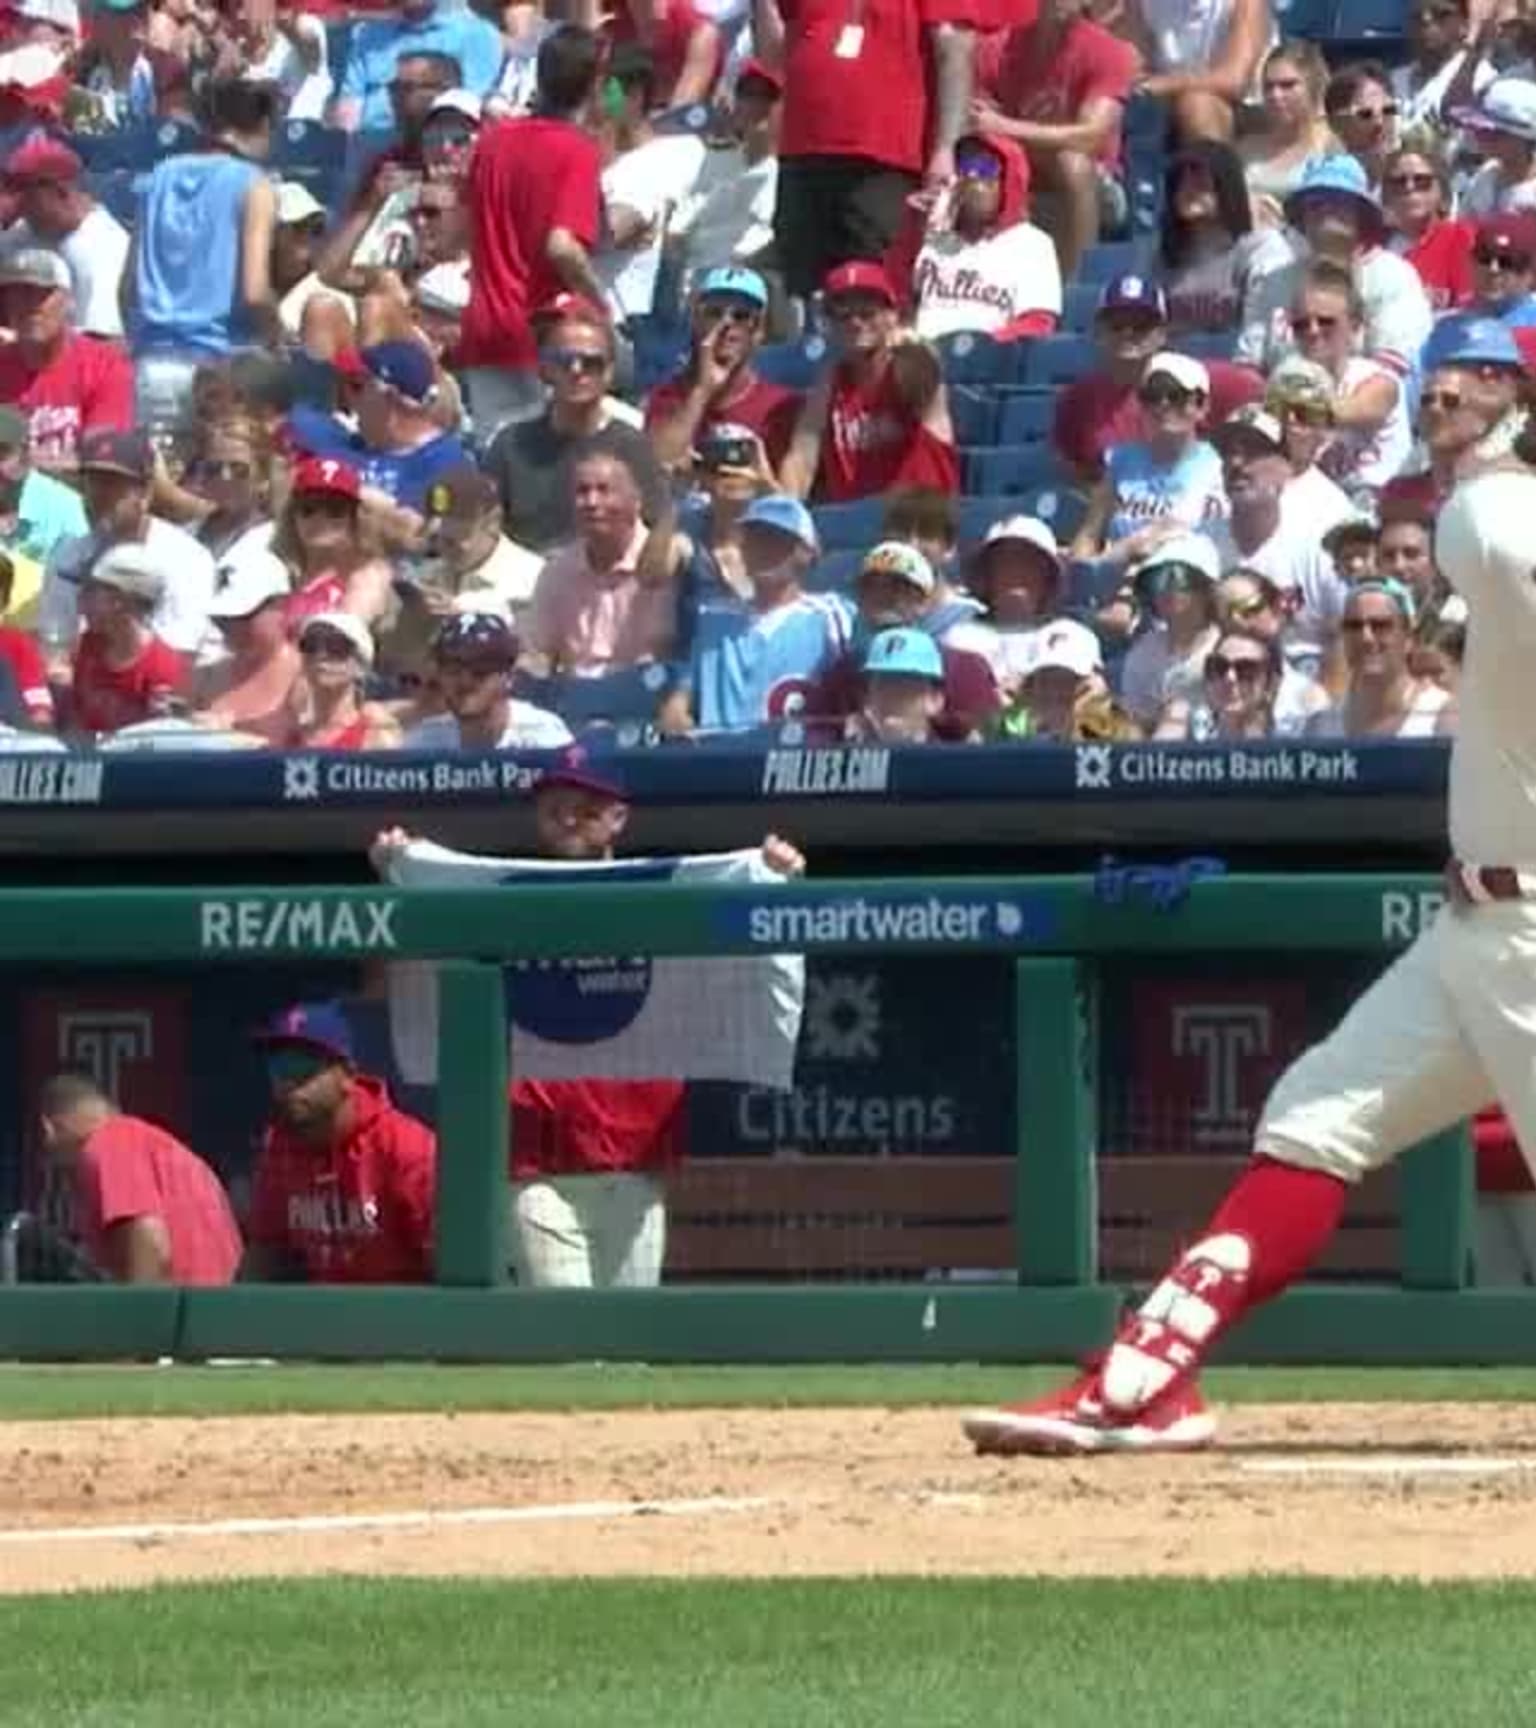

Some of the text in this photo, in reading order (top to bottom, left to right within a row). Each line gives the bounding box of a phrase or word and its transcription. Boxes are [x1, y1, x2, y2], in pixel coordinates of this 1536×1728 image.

[326, 761, 430, 791] Citizens
[432, 759, 499, 790] Bank
[761, 748, 890, 794] PHILLIES.COM
[1120, 748, 1358, 782] Citizens Bank Park
[201, 900, 398, 949] RE/MAX
[750, 897, 987, 943] smartwater
[737, 1082, 958, 1140] Citizens
